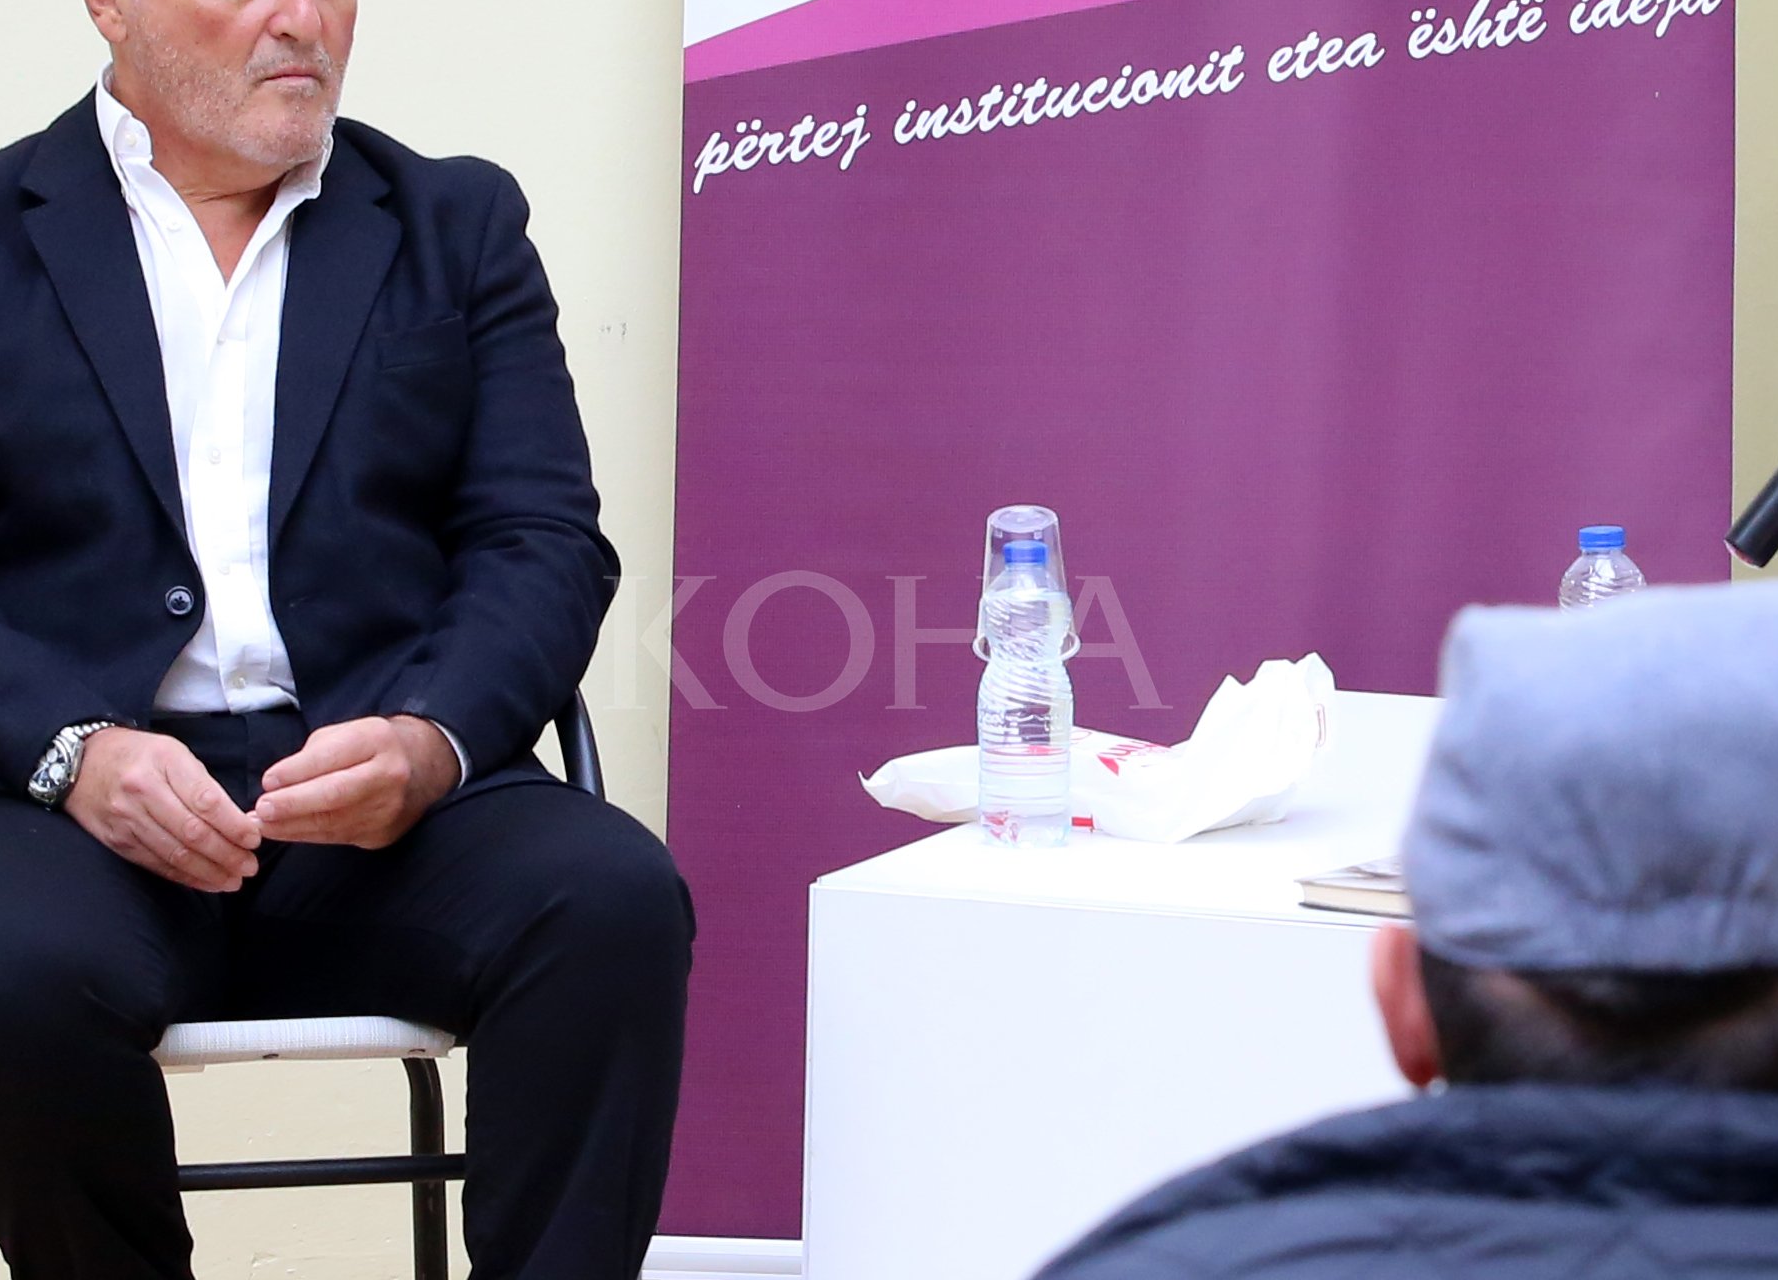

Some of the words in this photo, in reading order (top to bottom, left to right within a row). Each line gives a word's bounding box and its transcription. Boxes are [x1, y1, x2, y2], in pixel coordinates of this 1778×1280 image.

[693, 104, 871, 194] përtej
[894, 45, 1245, 144] institucionit
[1267, 31, 1385, 82] etea
